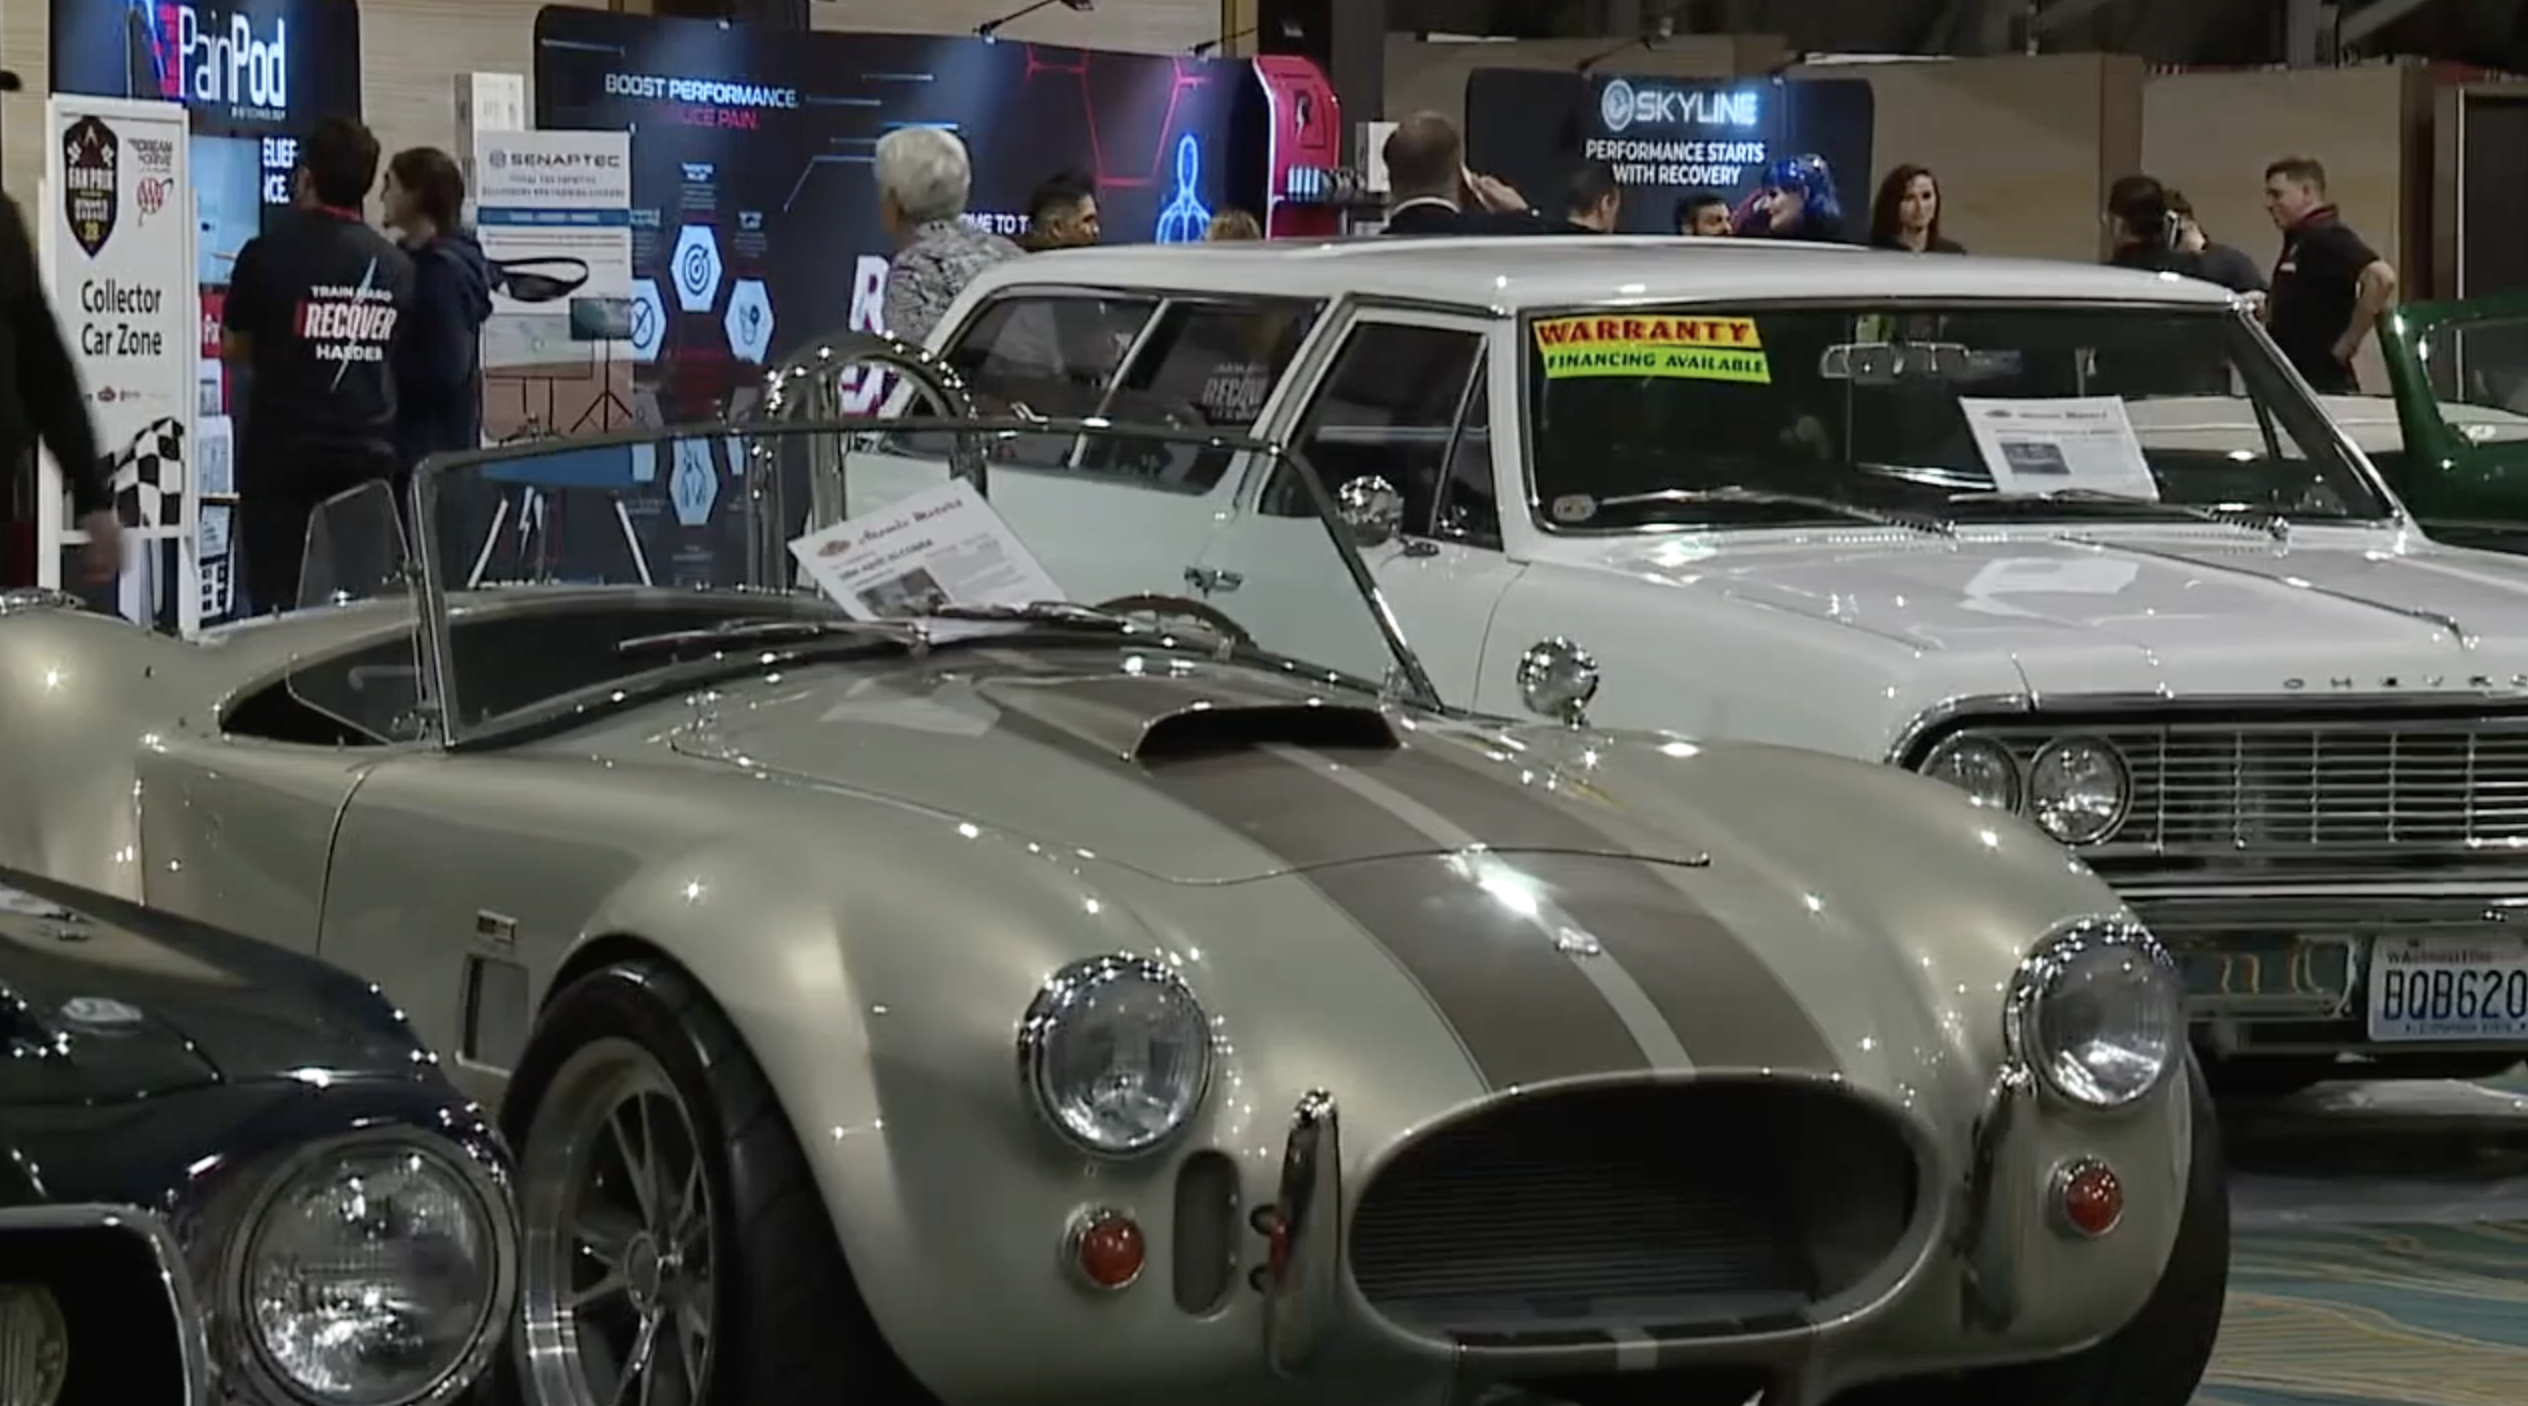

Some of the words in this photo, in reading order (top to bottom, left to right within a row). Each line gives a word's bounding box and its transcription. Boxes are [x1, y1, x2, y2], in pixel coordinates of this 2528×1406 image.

[179, 5, 286, 108] PainPod
[605, 73, 667, 98] BOOST
[1635, 91, 1758, 125] SKYLINE
[511, 153, 621, 167] SENAPTEC
[1585, 139, 1704, 162] PERFORMANCE
[1707, 143, 1765, 163] STARTS
[1612, 163, 1655, 184] WITH
[1658, 164, 1741, 185] RECOVERY
[995, 213, 1017, 234] TO
[82, 279, 161, 314] Collector
[311, 285, 354, 298] TRAIN
[304, 303, 397, 340] RECOVER
[1539, 320, 1748, 346] WARRANTY
[82, 322, 112, 356] Car
[117, 323, 162, 356] Zone
[1548, 353, 1656, 369] FINANCING
[1666, 353, 1764, 373] AVAILABLE
[2384, 969, 2527, 1020] BQB620
